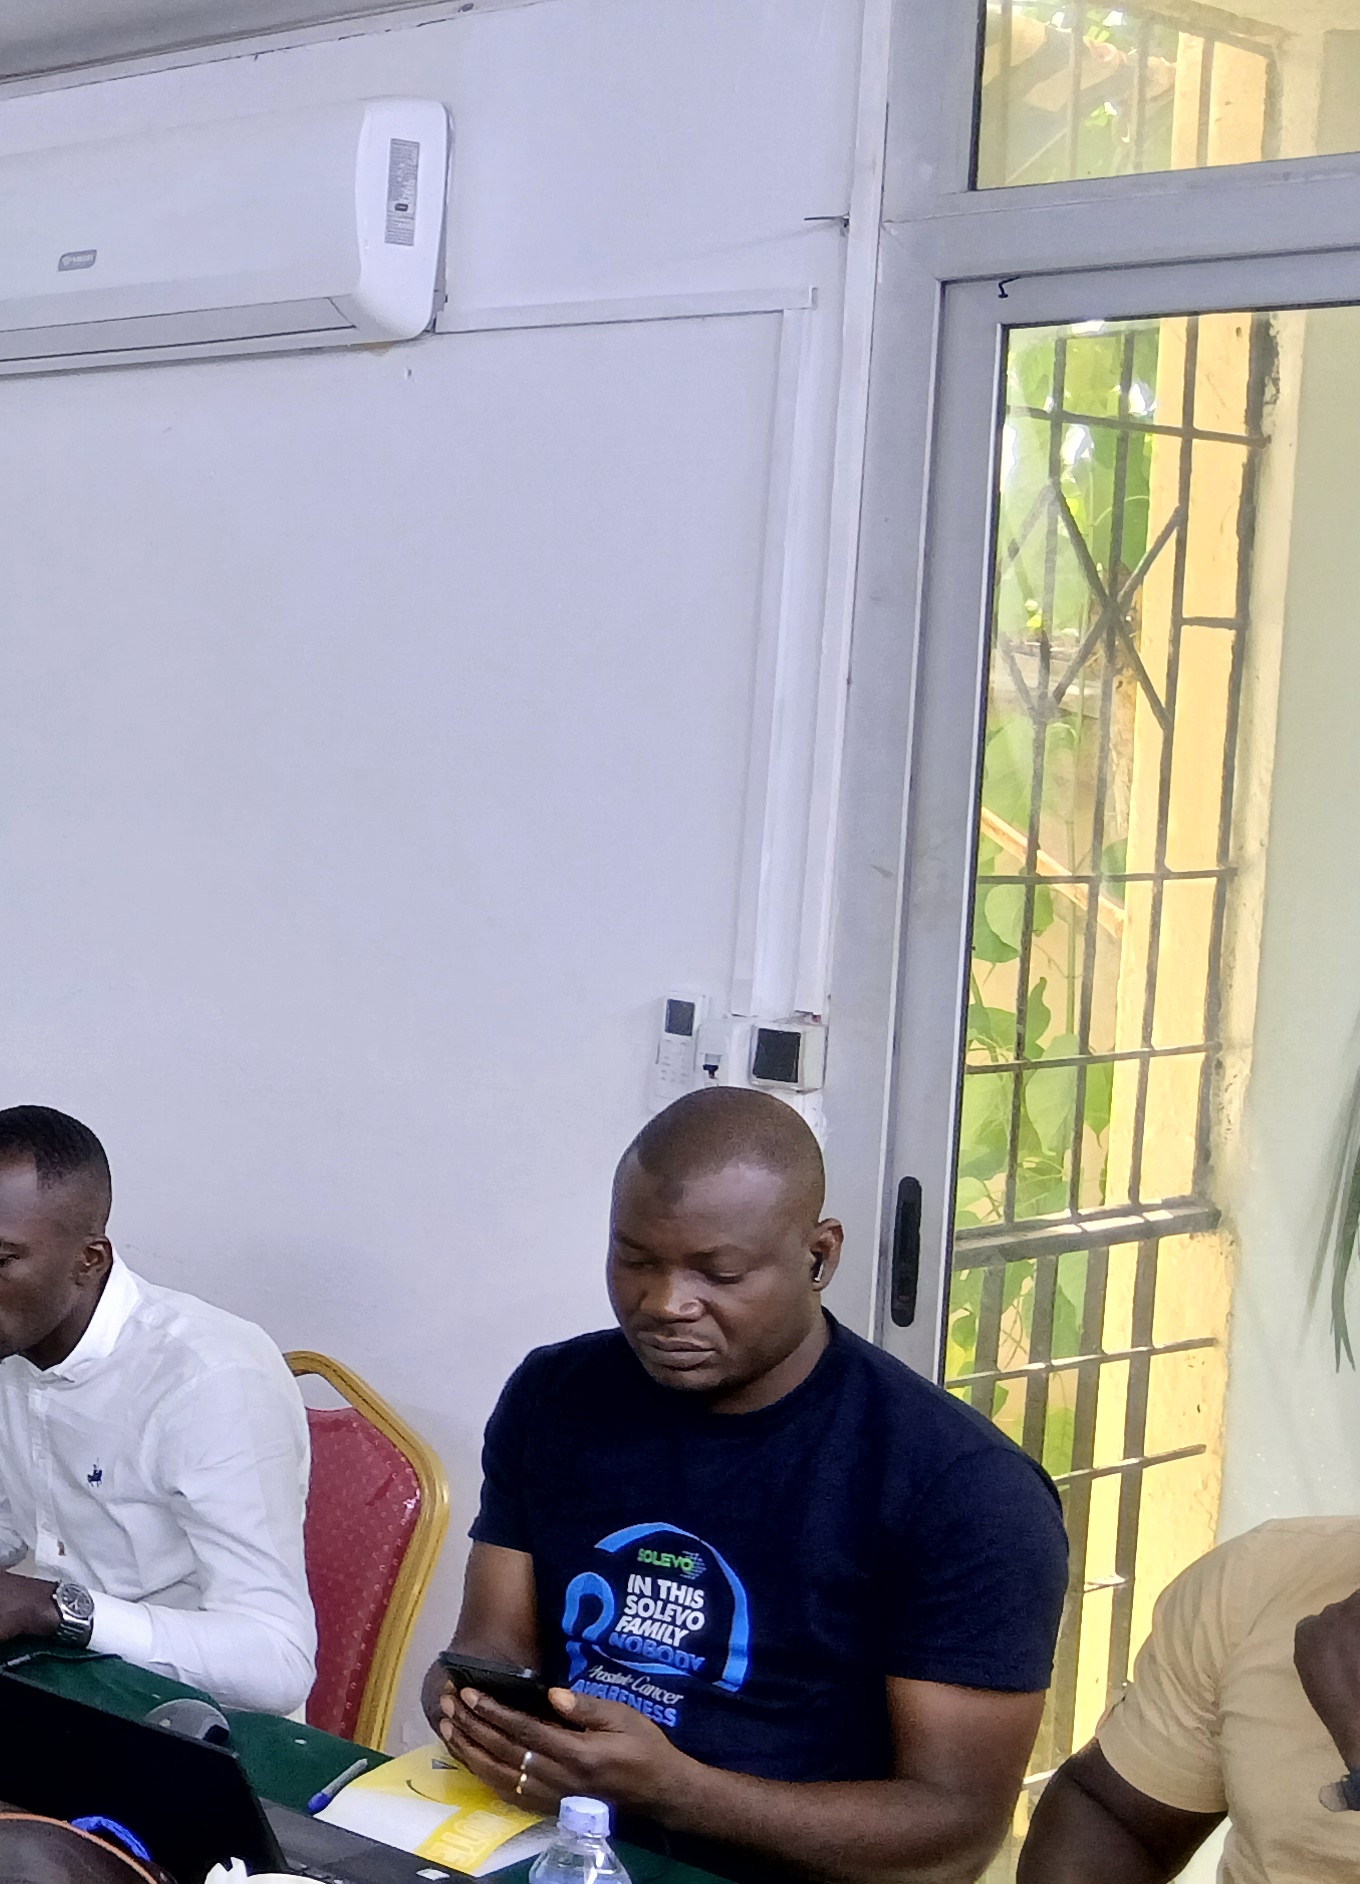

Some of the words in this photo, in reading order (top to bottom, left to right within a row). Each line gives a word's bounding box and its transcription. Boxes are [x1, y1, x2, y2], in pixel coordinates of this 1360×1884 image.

[637, 1548, 695, 1572] SOLEVO
[627, 1573, 652, 1596] IN
[657, 1579, 705, 1610] THIS
[624, 1595, 706, 1631] SOLEVO
[615, 1616, 690, 1648] FAMILY
[608, 1632, 706, 1672] NOBODY
[631, 1675, 685, 1706] Cancer
